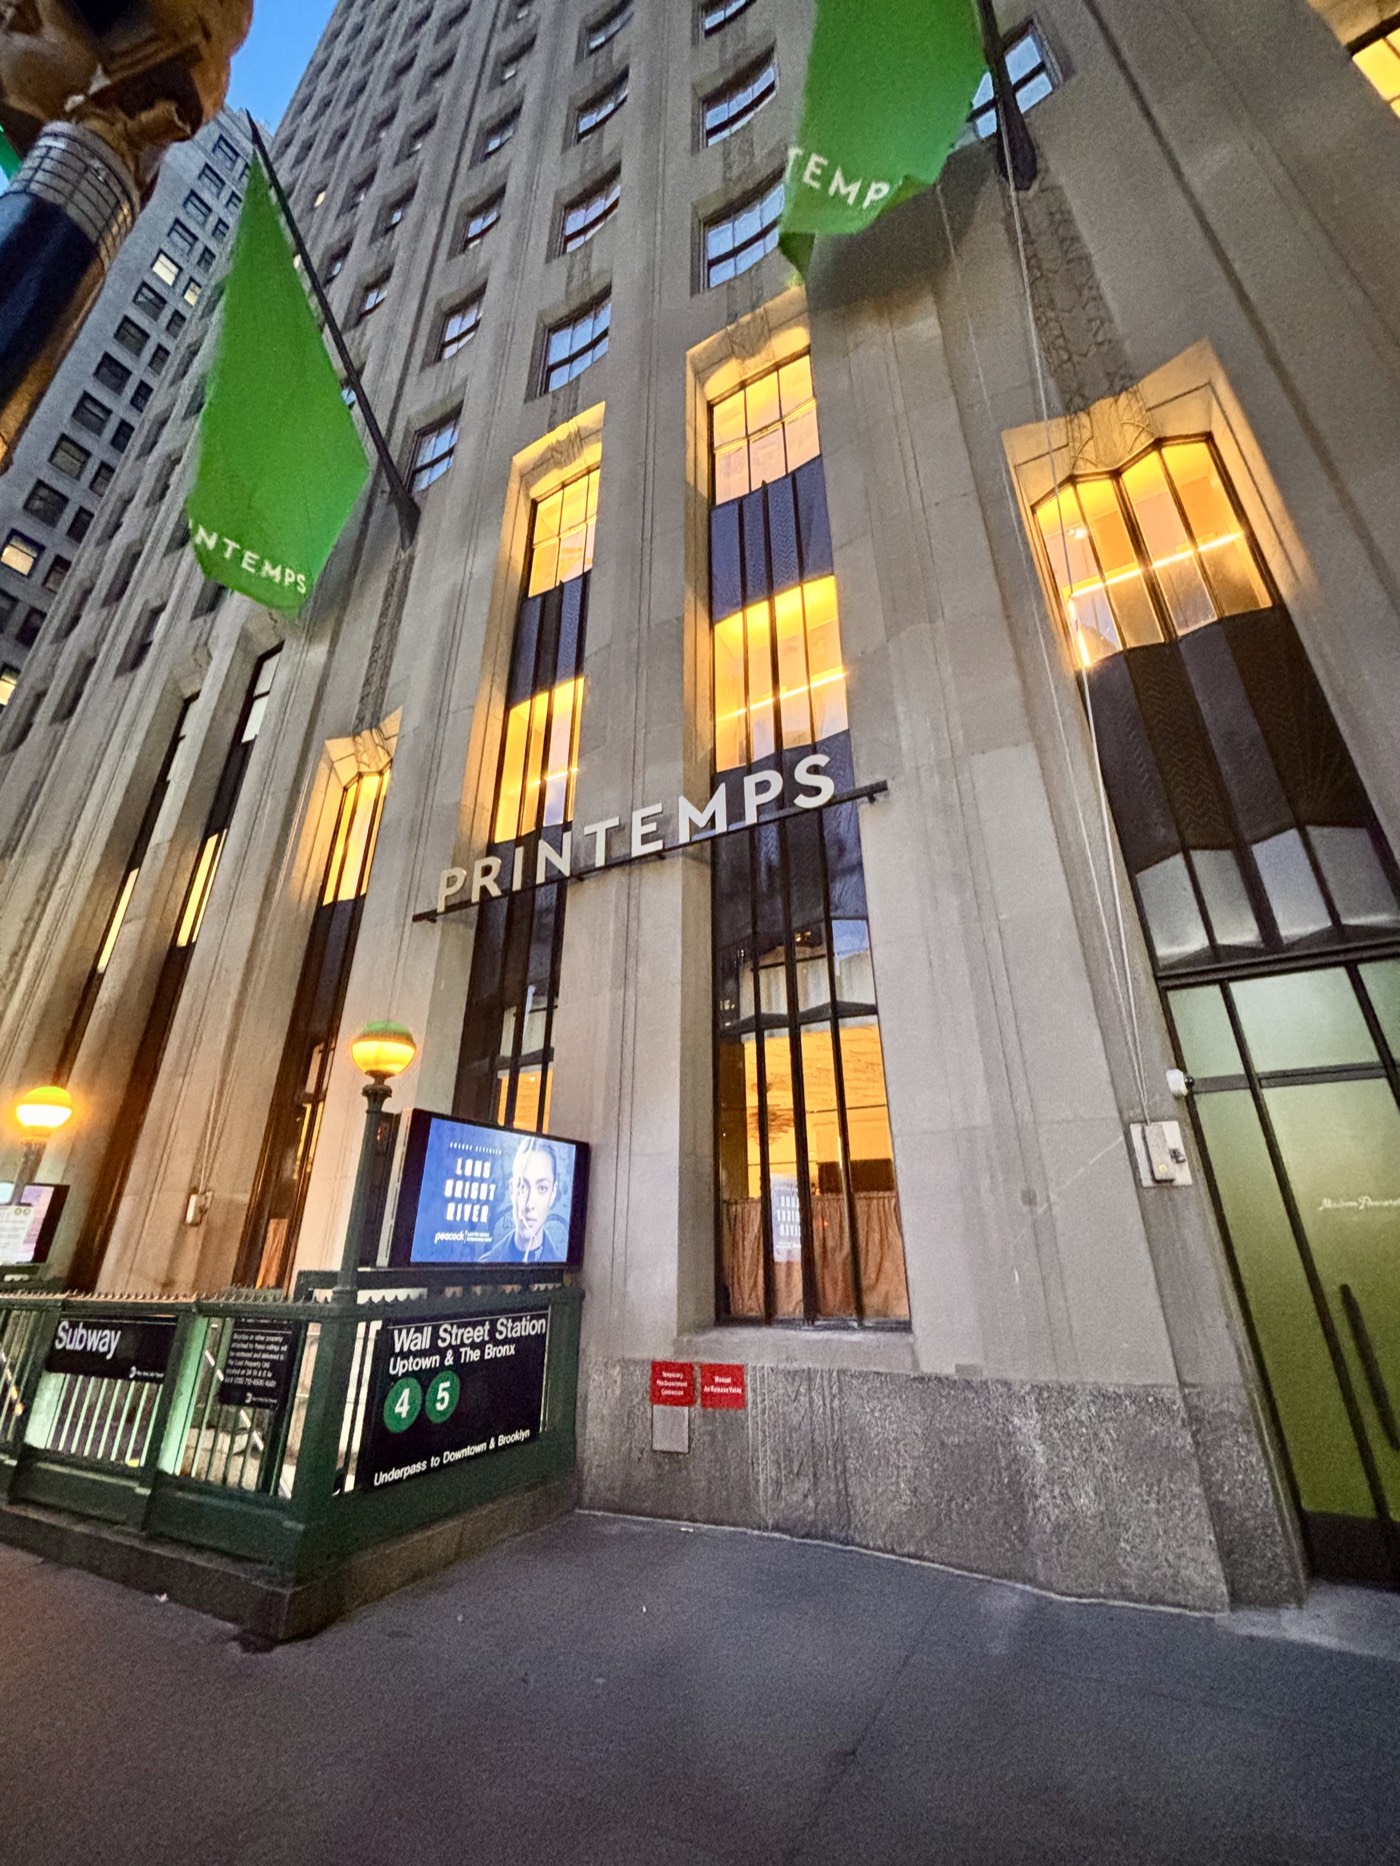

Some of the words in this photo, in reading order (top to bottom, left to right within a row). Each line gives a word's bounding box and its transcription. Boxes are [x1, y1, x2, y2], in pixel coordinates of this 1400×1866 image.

[436, 754, 836, 913] PRINTEMPS
[455, 1157, 491, 1179] LONG
[446, 1202, 489, 1223] RIVER
[434, 1230, 465, 1243] peacock
[55, 1320, 121, 1360] Subway
[393, 1326, 432, 1353] Wall
[437, 1322, 490, 1348] Street
[495, 1315, 546, 1340] Station
[389, 1353, 440, 1377] Uptown
[444, 1349, 454, 1366] &
[459, 1346, 480, 1364] The
[484, 1343, 516, 1360] Bronx
[714, 1376, 731, 1384] Manual
[394, 1387, 410, 1419] 4
[435, 1381, 451, 1411] 5
[373, 1458, 427, 1487] Underpass
[430, 1456, 441, 1467] to
[442, 1441, 487, 1465] Downtown
[488, 1437, 496, 1450] &
[497, 1428, 530, 1447] Brooklyn
